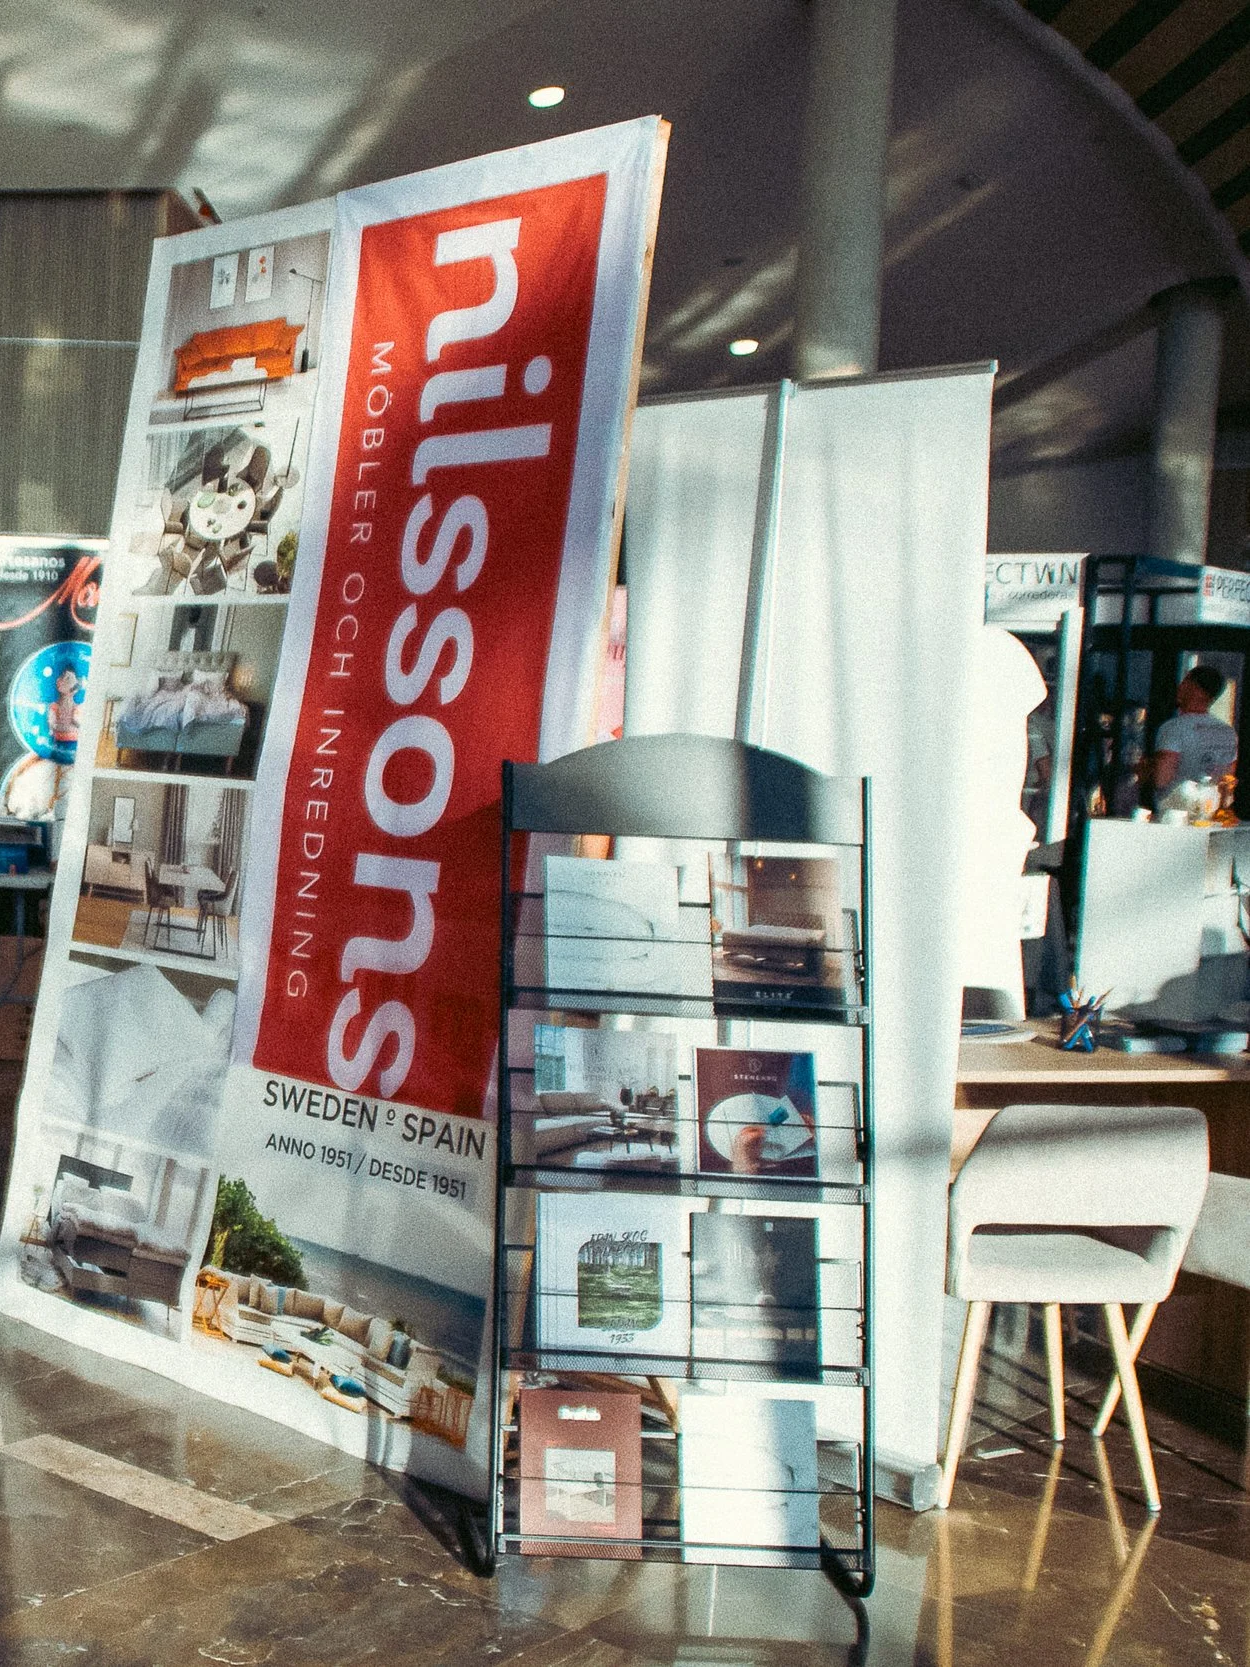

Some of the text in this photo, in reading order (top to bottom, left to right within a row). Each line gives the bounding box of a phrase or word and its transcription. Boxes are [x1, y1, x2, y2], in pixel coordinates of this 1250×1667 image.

[287, 341, 395, 998] MÖBLER OCH INREDNING
[327, 217, 552, 1098] nilssons
[262, 1080, 378, 1133] SWEDEN
[401, 1112, 487, 1161] SPAIN
[265, 1133, 316, 1160] ANNO
[320, 1144, 353, 1171] 1951
[369, 1159, 427, 1190] DESDE
[432, 1172, 467, 1200] 1951
